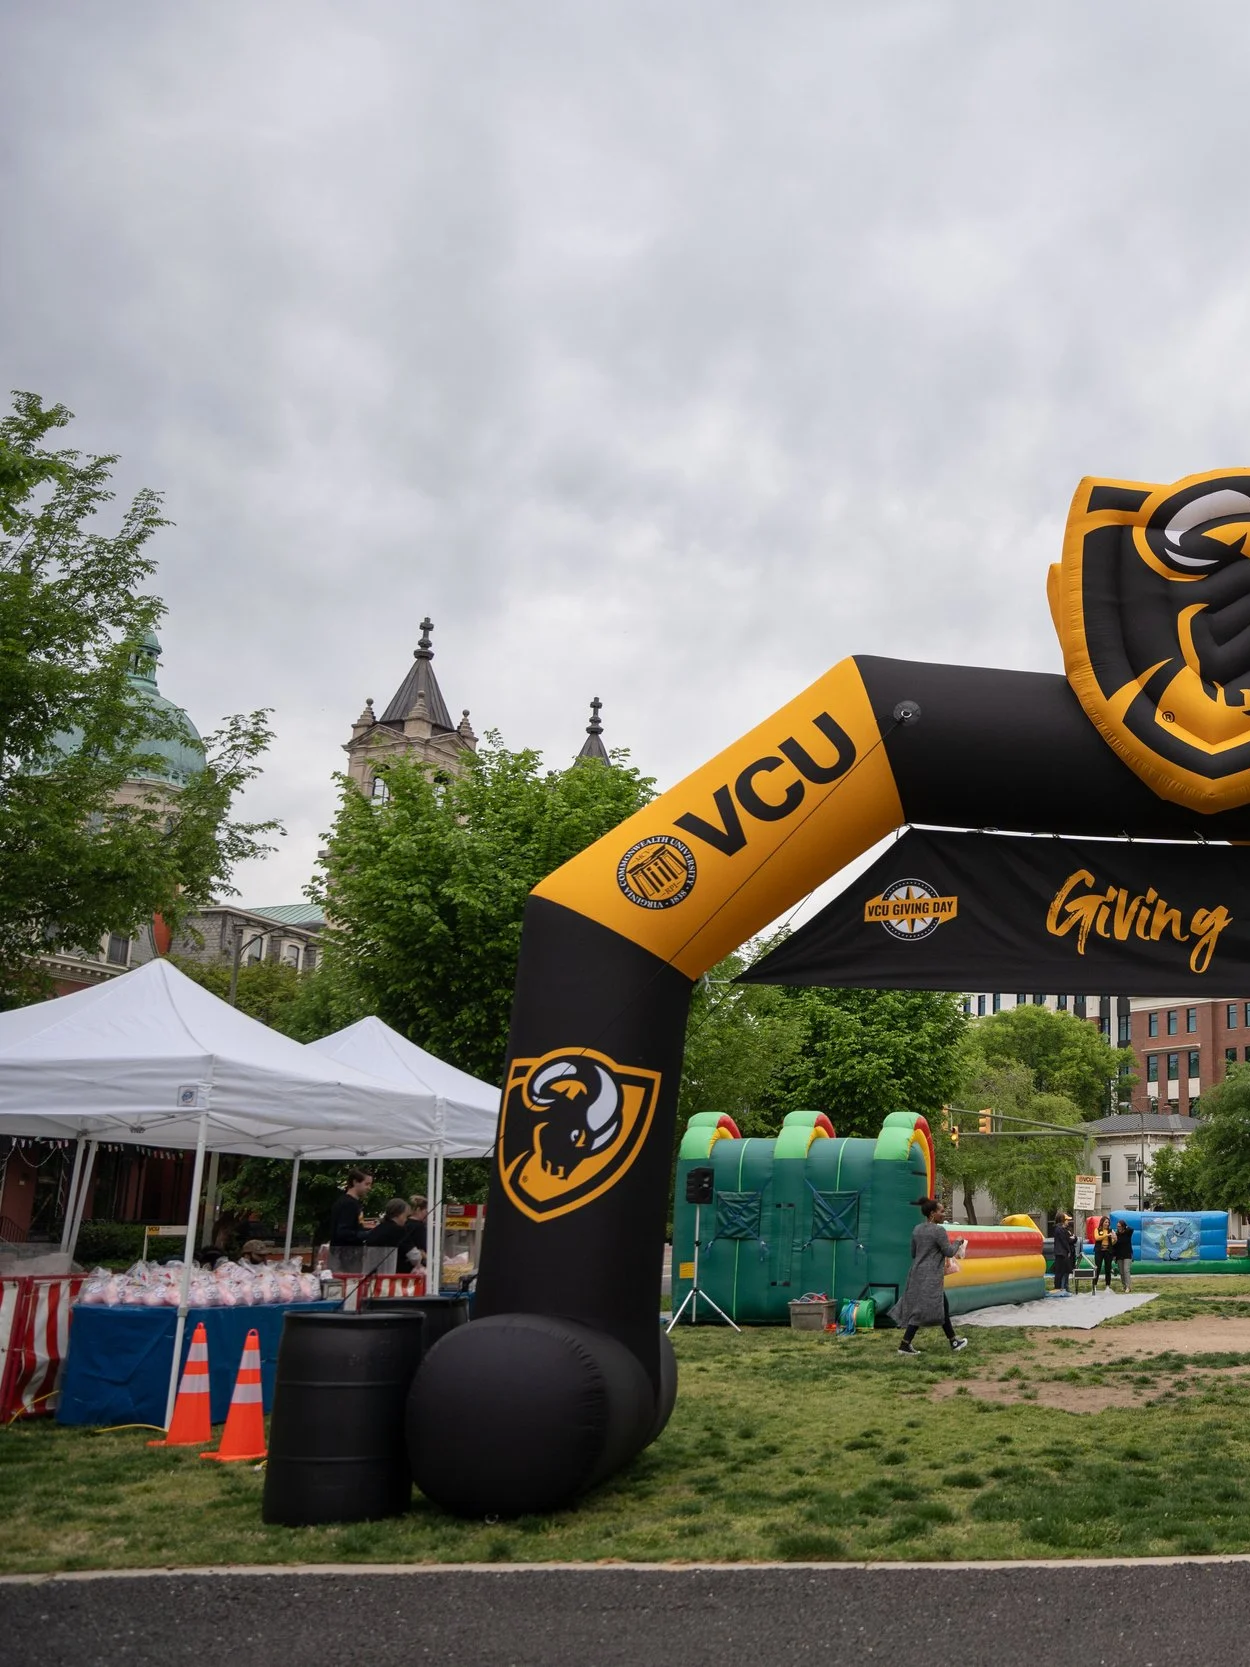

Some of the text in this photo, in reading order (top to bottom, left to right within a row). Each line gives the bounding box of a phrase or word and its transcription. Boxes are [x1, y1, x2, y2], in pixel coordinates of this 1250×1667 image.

[673, 711, 857, 857] VCU
[618, 836, 696, 908] VIRGINIA COMMONWEALTH UNIVERSITY
[868, 901, 954, 917] VCU GIVING DAY
[1045, 868, 1234, 974] Giving
